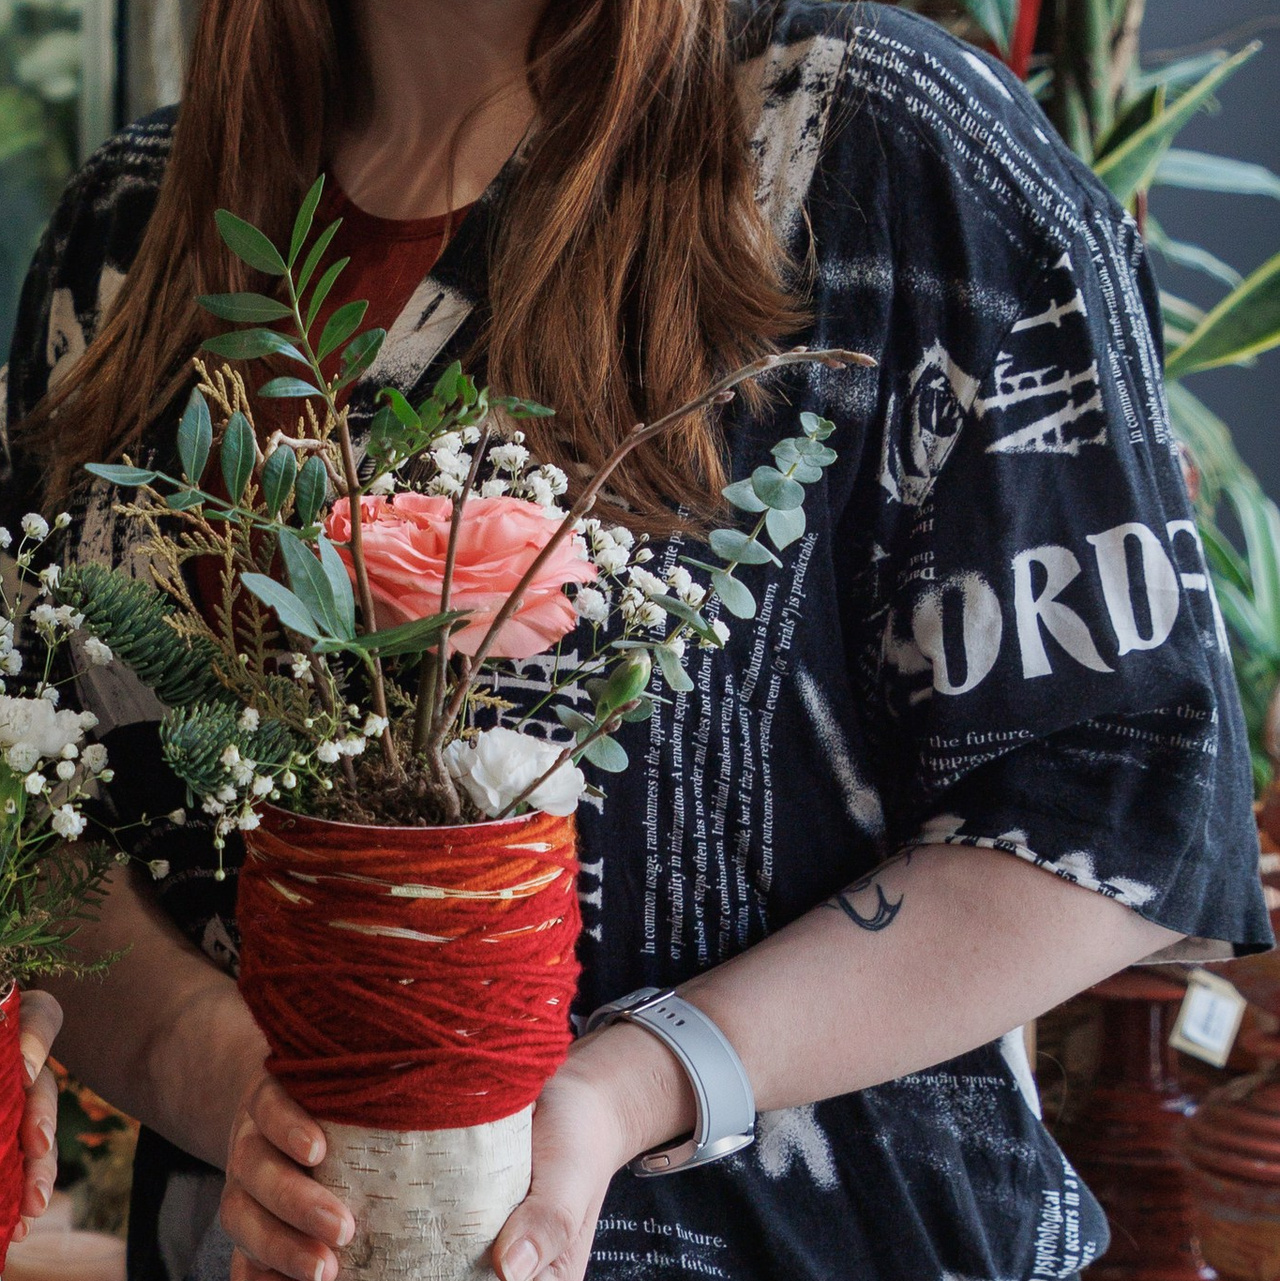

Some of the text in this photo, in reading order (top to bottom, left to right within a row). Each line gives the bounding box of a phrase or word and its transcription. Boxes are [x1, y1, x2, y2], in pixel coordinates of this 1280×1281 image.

[853, 26, 915, 57] Chaos:
[923, 52, 966, 95] When
[1100, 265, 1124, 338] information.
[1115, 380, 1140, 428] common
[658, 545, 678, 582] efinite
[790, 532, 820, 599] predictable.
[756, 582, 779, 625] known,
[784, 595, 800, 608] is
[753, 625, 768, 638] is
[697, 654, 713, 691] follow
[737, 638, 766, 703] distribution
[700, 694, 712, 716] not
[766, 674, 781, 710] events
[693, 717, 711, 744] does
[720, 697, 733, 733] events
[759, 709, 773, 758] repeated
[929, 728, 1035, 749] the future.
[644, 746, 661, 766] the
[692, 742, 707, 764] and
[717, 736, 731, 781] random
[644, 767, 659, 778] is
[690, 765, 704, 798] order
[738, 770, 753, 790] the
[762, 761, 772, 787] over
[695, 800, 705, 816] no
[710, 780, 730, 836] Individual
[738, 791, 751, 804] if
[642, 779, 658, 851] randomness
[666, 690, 690, 959] or predictability in information. A random seque
[693, 819, 707, 839] has
[737, 806, 751, 825] but
[762, 789, 773, 845] outcomes
[646, 854, 663, 889] usage,
[693, 842, 707, 872] often
[694, 873, 711, 902] steps
[715, 840, 731, 915] combination.
[644, 890, 656, 939] common
[694, 904, 704, 918] or
[640, 941, 656, 954] In
[1063, 1192, 1080, 1207] in
[643, 1217, 673, 1236] the
[675, 1222, 728, 1249] future.
[1031, 1189, 1064, 1277] psychological
[1063, 1209, 1080, 1253] occurs
